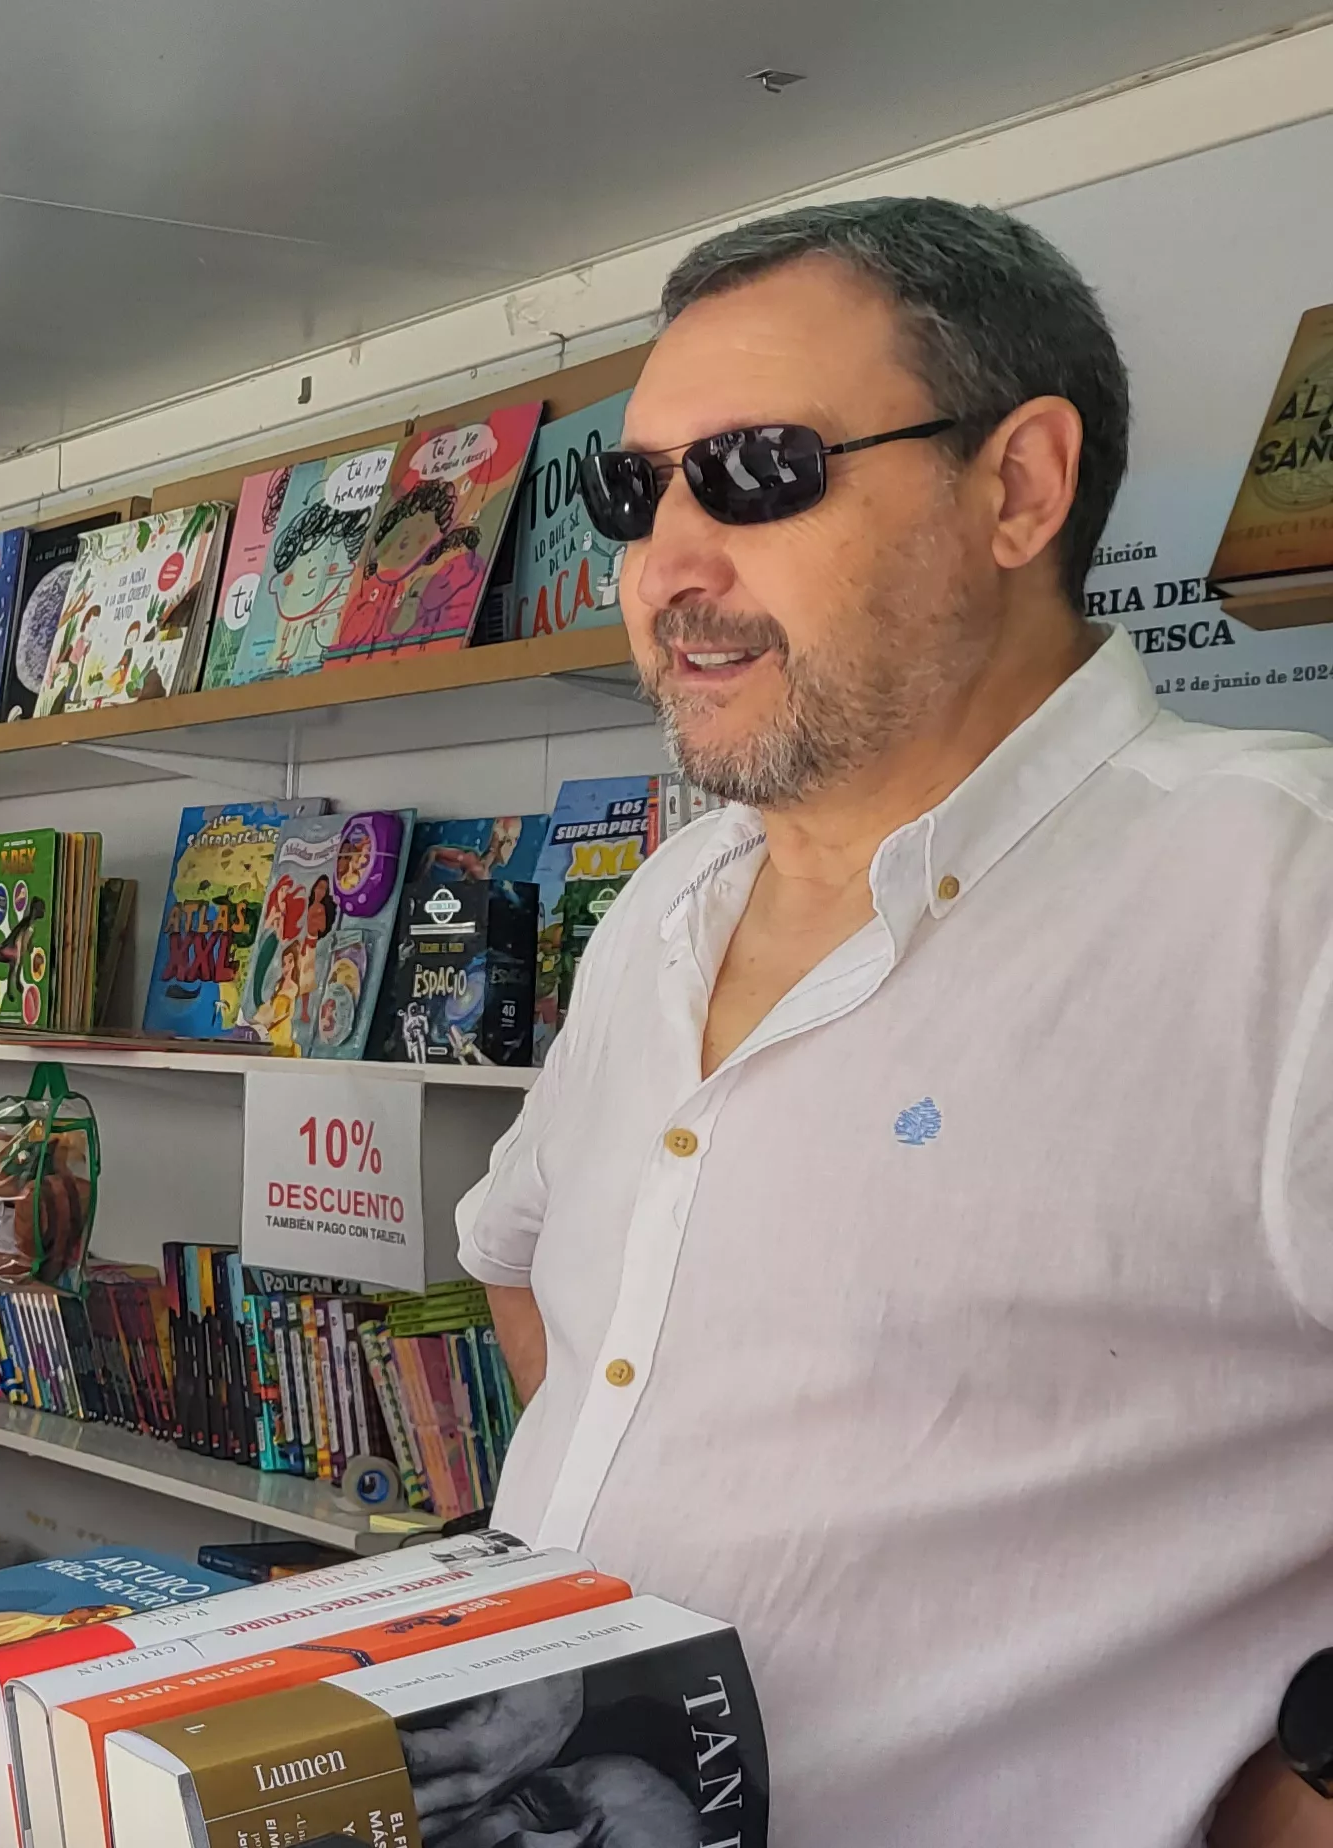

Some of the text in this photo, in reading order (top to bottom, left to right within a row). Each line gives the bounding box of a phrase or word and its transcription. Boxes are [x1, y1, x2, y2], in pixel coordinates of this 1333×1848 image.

[534, 524, 568, 562] LO QUE
[549, 537, 577, 577] DE LA
[1094, 542, 1157, 566] dición
[1085, 586, 1145, 617] RIA
[1129, 619, 1236, 654] ESCA
[1155, 668, 1287, 695] al 2 de junio de
[612, 800, 645, 816] LOS
[569, 842, 643, 877] XXL
[164, 900, 251, 934] ATLAS
[161, 931, 239, 983] XXL
[413, 967, 467, 999] ESPACIO
[502, 1004, 516, 1018] 40
[299, 1116, 382, 1174] 10%
[268, 1182, 405, 1224] DESCUENTO
[265, 1214, 407, 1246] TAMBIÉN PAGO CON TARJETA
[36, 1558, 176, 1609] PÉREZ-REVERT
[84, 1555, 211, 1598] ARTURO
[397, 1570, 474, 1594] MUERTE
[78, 1645, 178, 1677] CRISTIAN
[469, 1621, 644, 1669] Hanya Yanagihara
[108, 1658, 277, 1705] CRISTINA VATRA
[681, 1673, 744, 1817] TAN
[253, 1748, 347, 1793] Lumen
